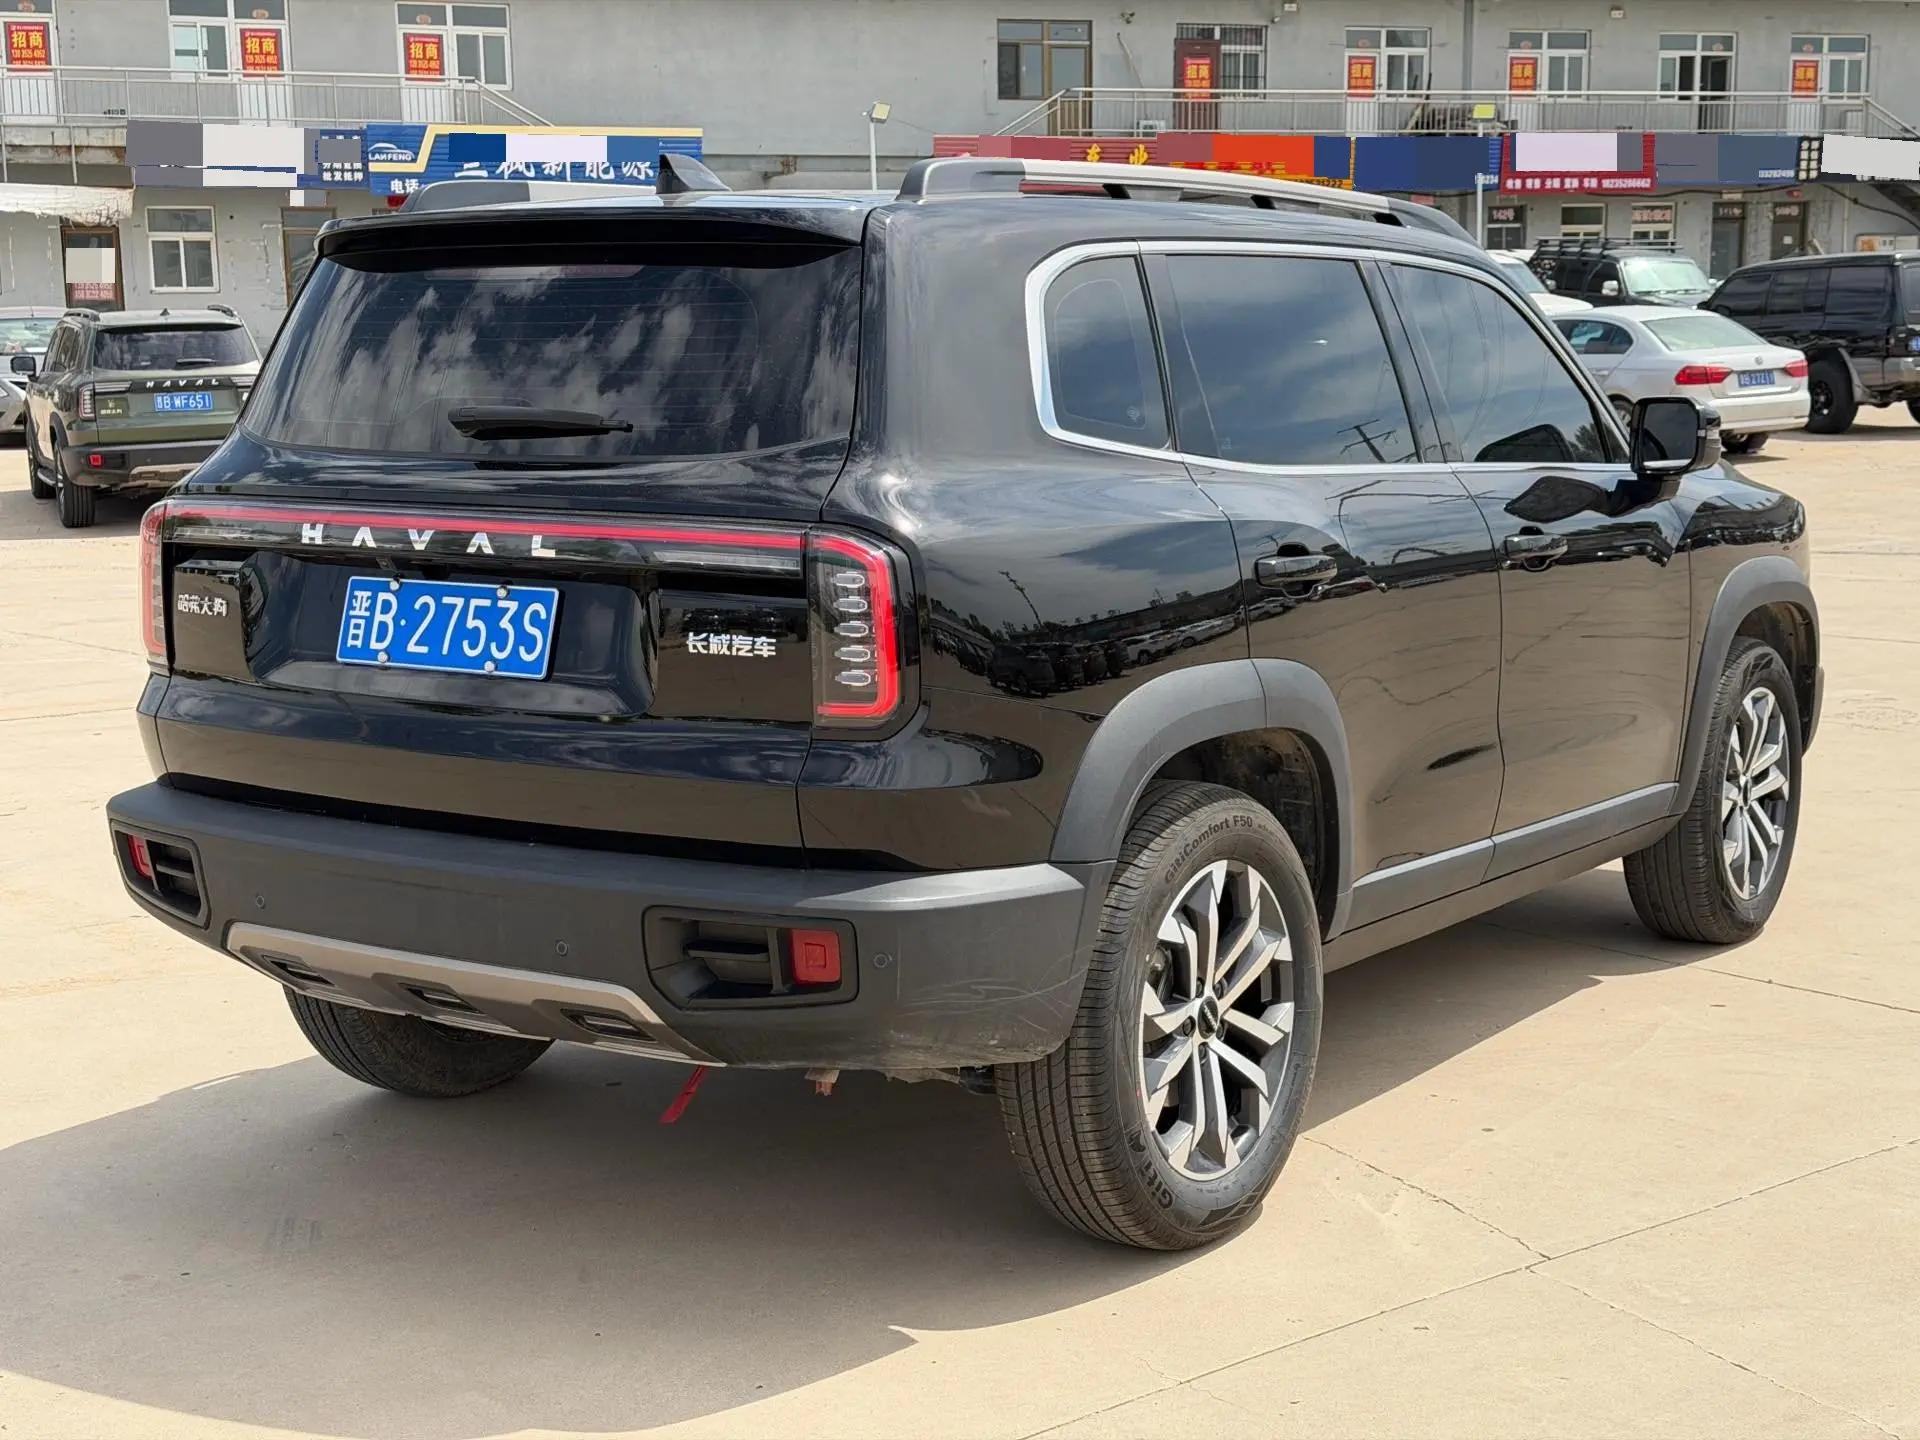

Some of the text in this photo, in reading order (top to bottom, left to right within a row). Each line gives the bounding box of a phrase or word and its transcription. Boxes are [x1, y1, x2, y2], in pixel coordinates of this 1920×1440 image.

[11, 31, 43, 48] 招商
[245, 37, 275, 54] 招商
[410, 42, 438, 59] 招商
[390, 178, 420, 194] 电话
[146, 378, 219, 388] HAVAL
[301, 523, 556, 558] HAVAL
[346, 590, 547, 662] 晋B·2753S
[686, 631, 777, 658] 长城汽车
[1164, 817, 1231, 884] GitiComfort
[1233, 815, 1253, 828] F50
[1140, 1160, 1174, 1209] Giti
